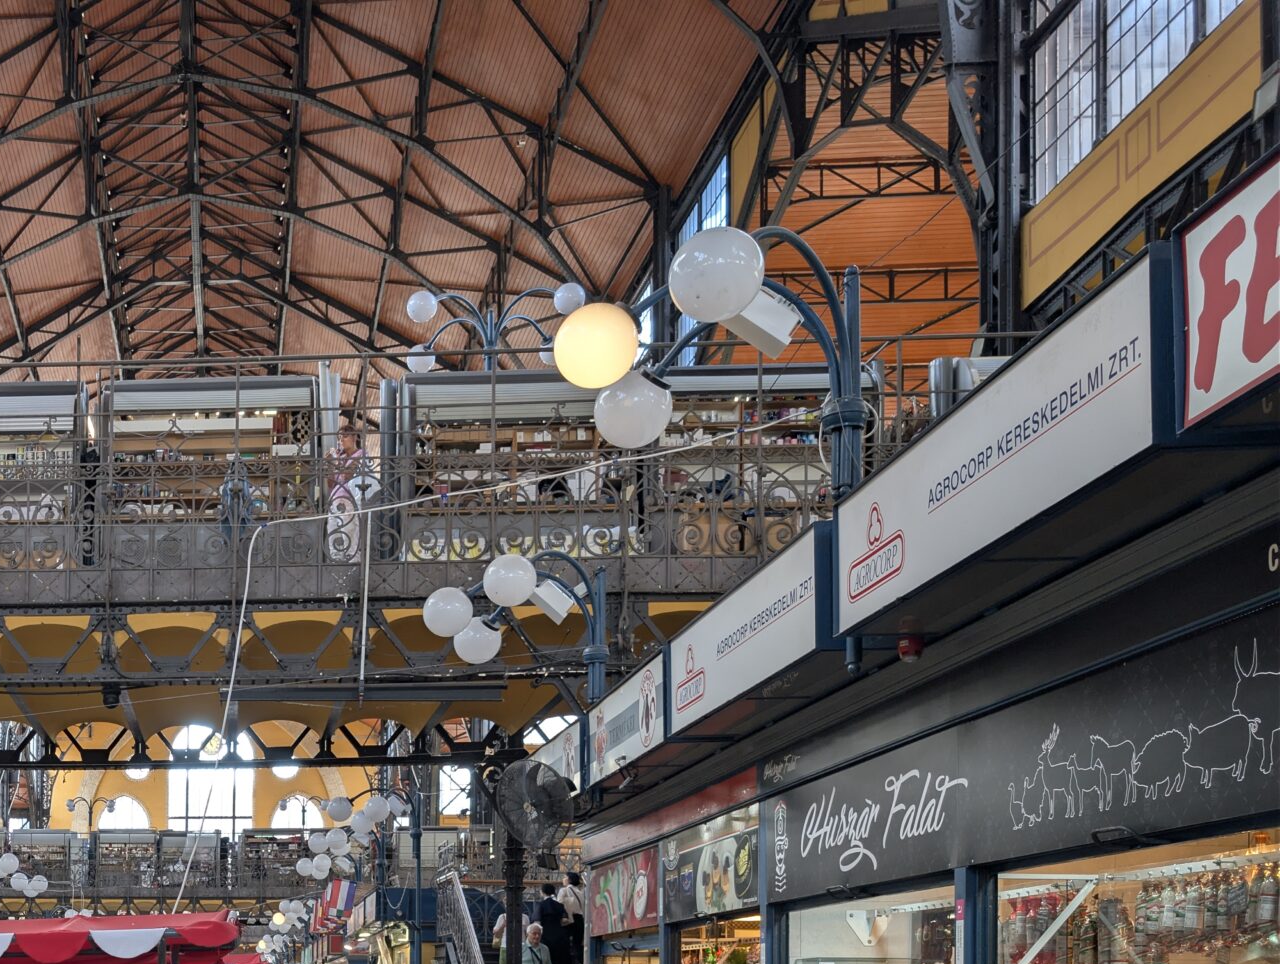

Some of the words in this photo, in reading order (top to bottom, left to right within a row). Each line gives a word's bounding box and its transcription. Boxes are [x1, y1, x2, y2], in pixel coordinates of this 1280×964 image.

[927, 446, 993, 509] AGROCORP
[997, 364, 1104, 460] KERESKEDELMI
[1108, 336, 1142, 380] ZRT.
[852, 544, 898, 592] AGROCORP
[716, 623, 748, 657] AGROCORP
[749, 590, 798, 633] KERESKEDELMI
[799, 576, 814, 600] ZRT.
[882, 769, 968, 849] Falat
